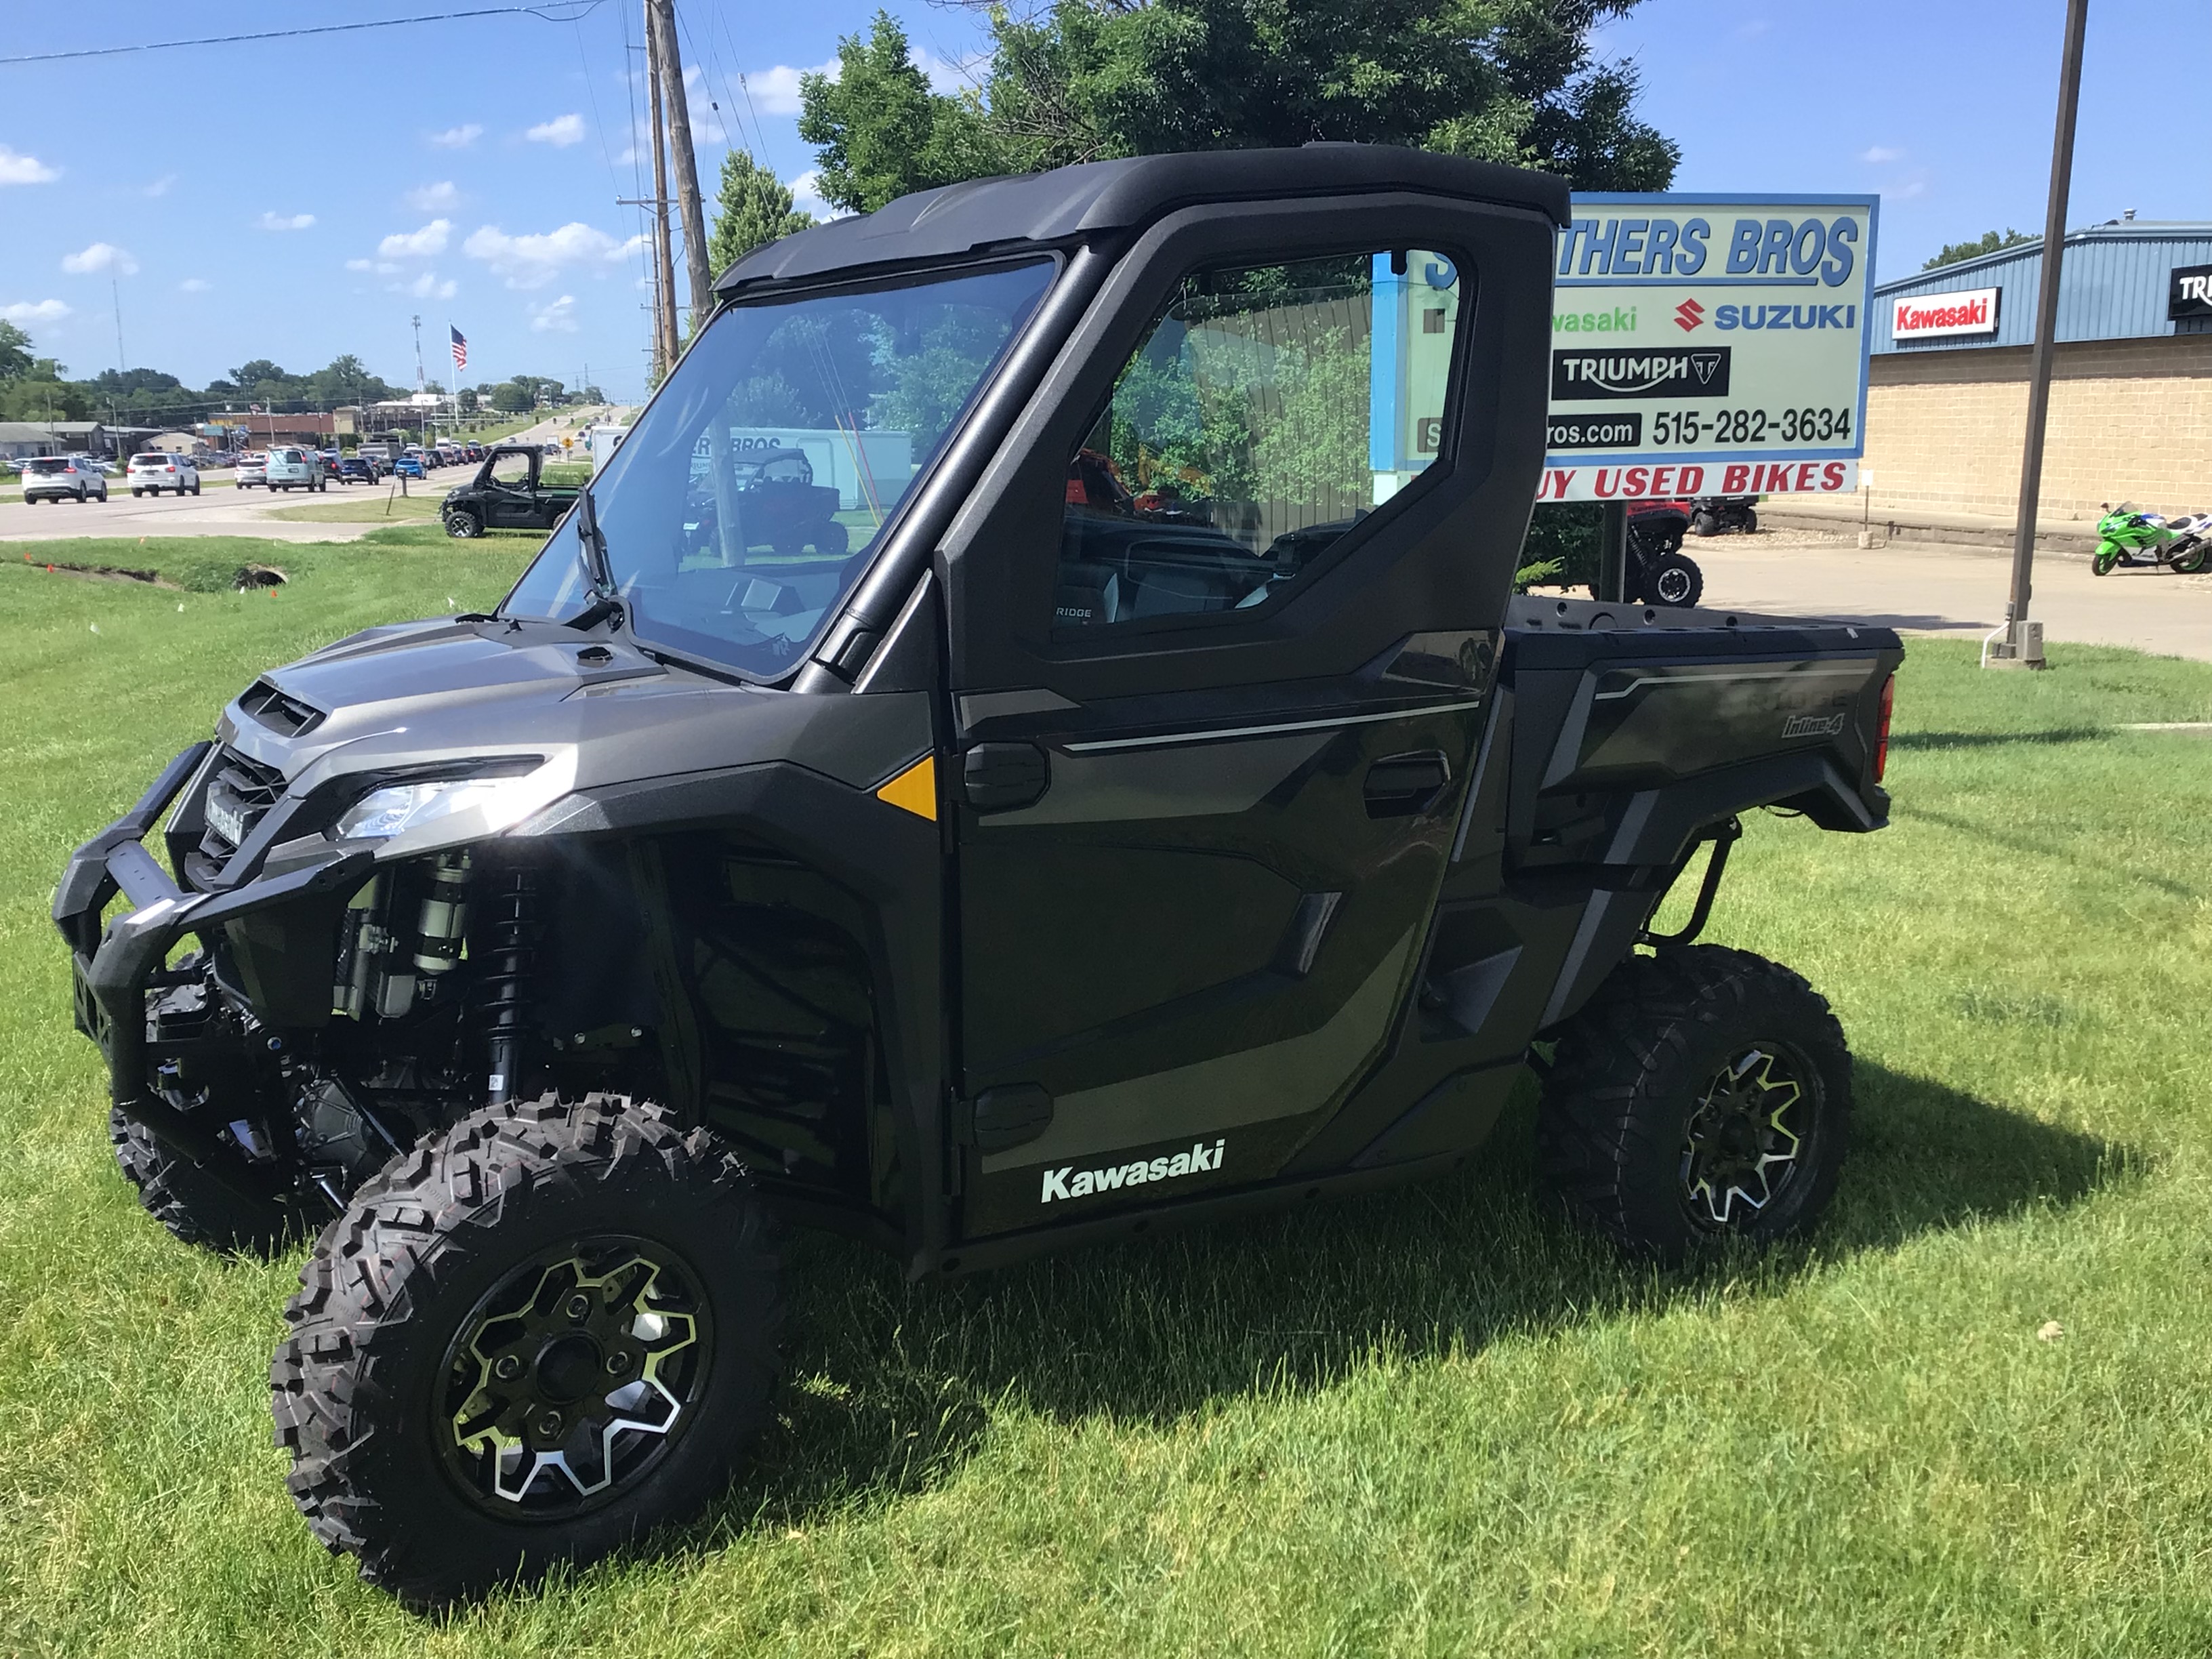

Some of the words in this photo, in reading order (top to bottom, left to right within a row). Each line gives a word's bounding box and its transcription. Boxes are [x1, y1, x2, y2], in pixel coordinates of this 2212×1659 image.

[1559, 218, 1711, 276] THERS
[1726, 216, 1858, 287] BROS
[2179, 274, 2212, 306] TRI
[1552, 306, 1637, 332] wasaki
[1715, 304, 1856, 330] SUZUKI
[1896, 298, 1988, 331] Kawasaki
[1563, 355, 1688, 392] TRIUMPH
[1547, 424, 1633, 444] ros.com
[1652, 407, 1851, 445] 515-282-3634
[1594, 466, 1704, 497] USED
[1721, 462, 1847, 494] BIKES
[1056, 607, 1092, 618] RIDGE
[1040, 1139, 1226, 1204] Kawasaki
